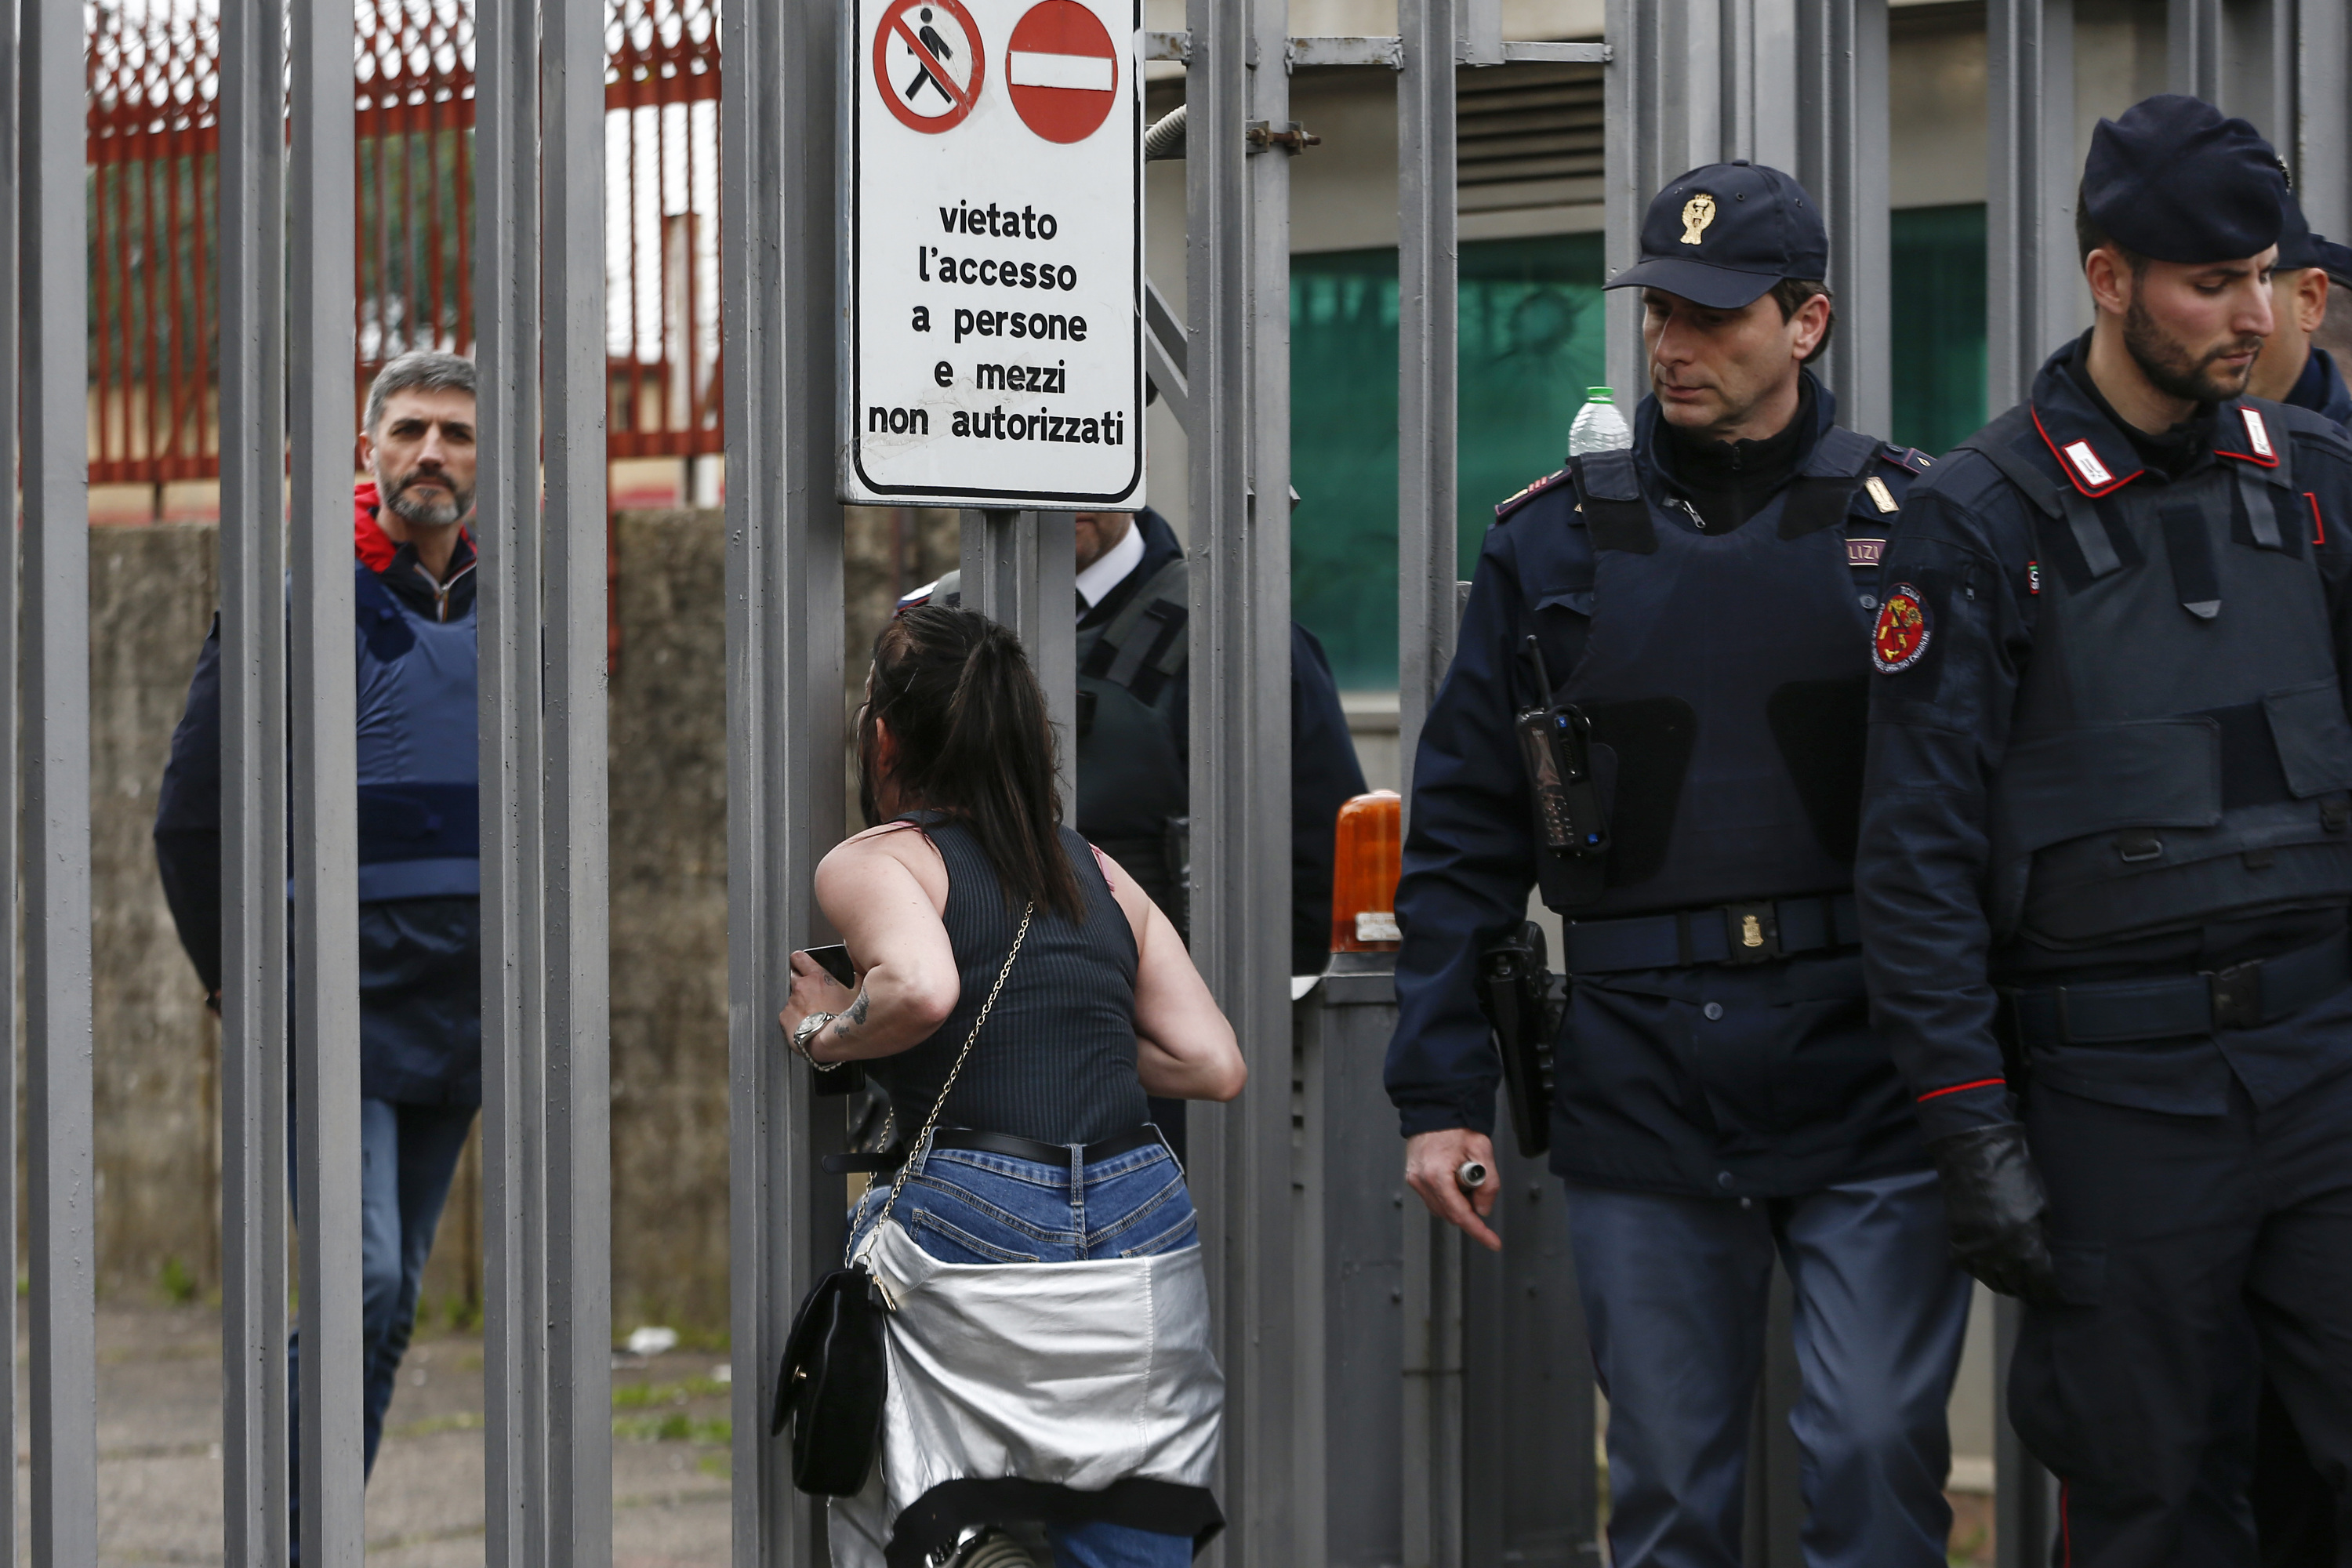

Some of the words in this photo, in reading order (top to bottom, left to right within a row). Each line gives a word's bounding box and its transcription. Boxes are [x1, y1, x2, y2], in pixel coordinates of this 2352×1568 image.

[939, 199, 1058, 241] vietato
[919, 245, 1077, 292] l'accesso
[912, 305, 931, 332] a
[954, 308, 1087, 344] persone
[934, 361, 953, 388] e
[977, 359, 1065, 394] mezzi
[869, 406, 929, 435] non
[952, 405, 1123, 446] autorizzati
[1847, 544, 1880, 560] LIZI
